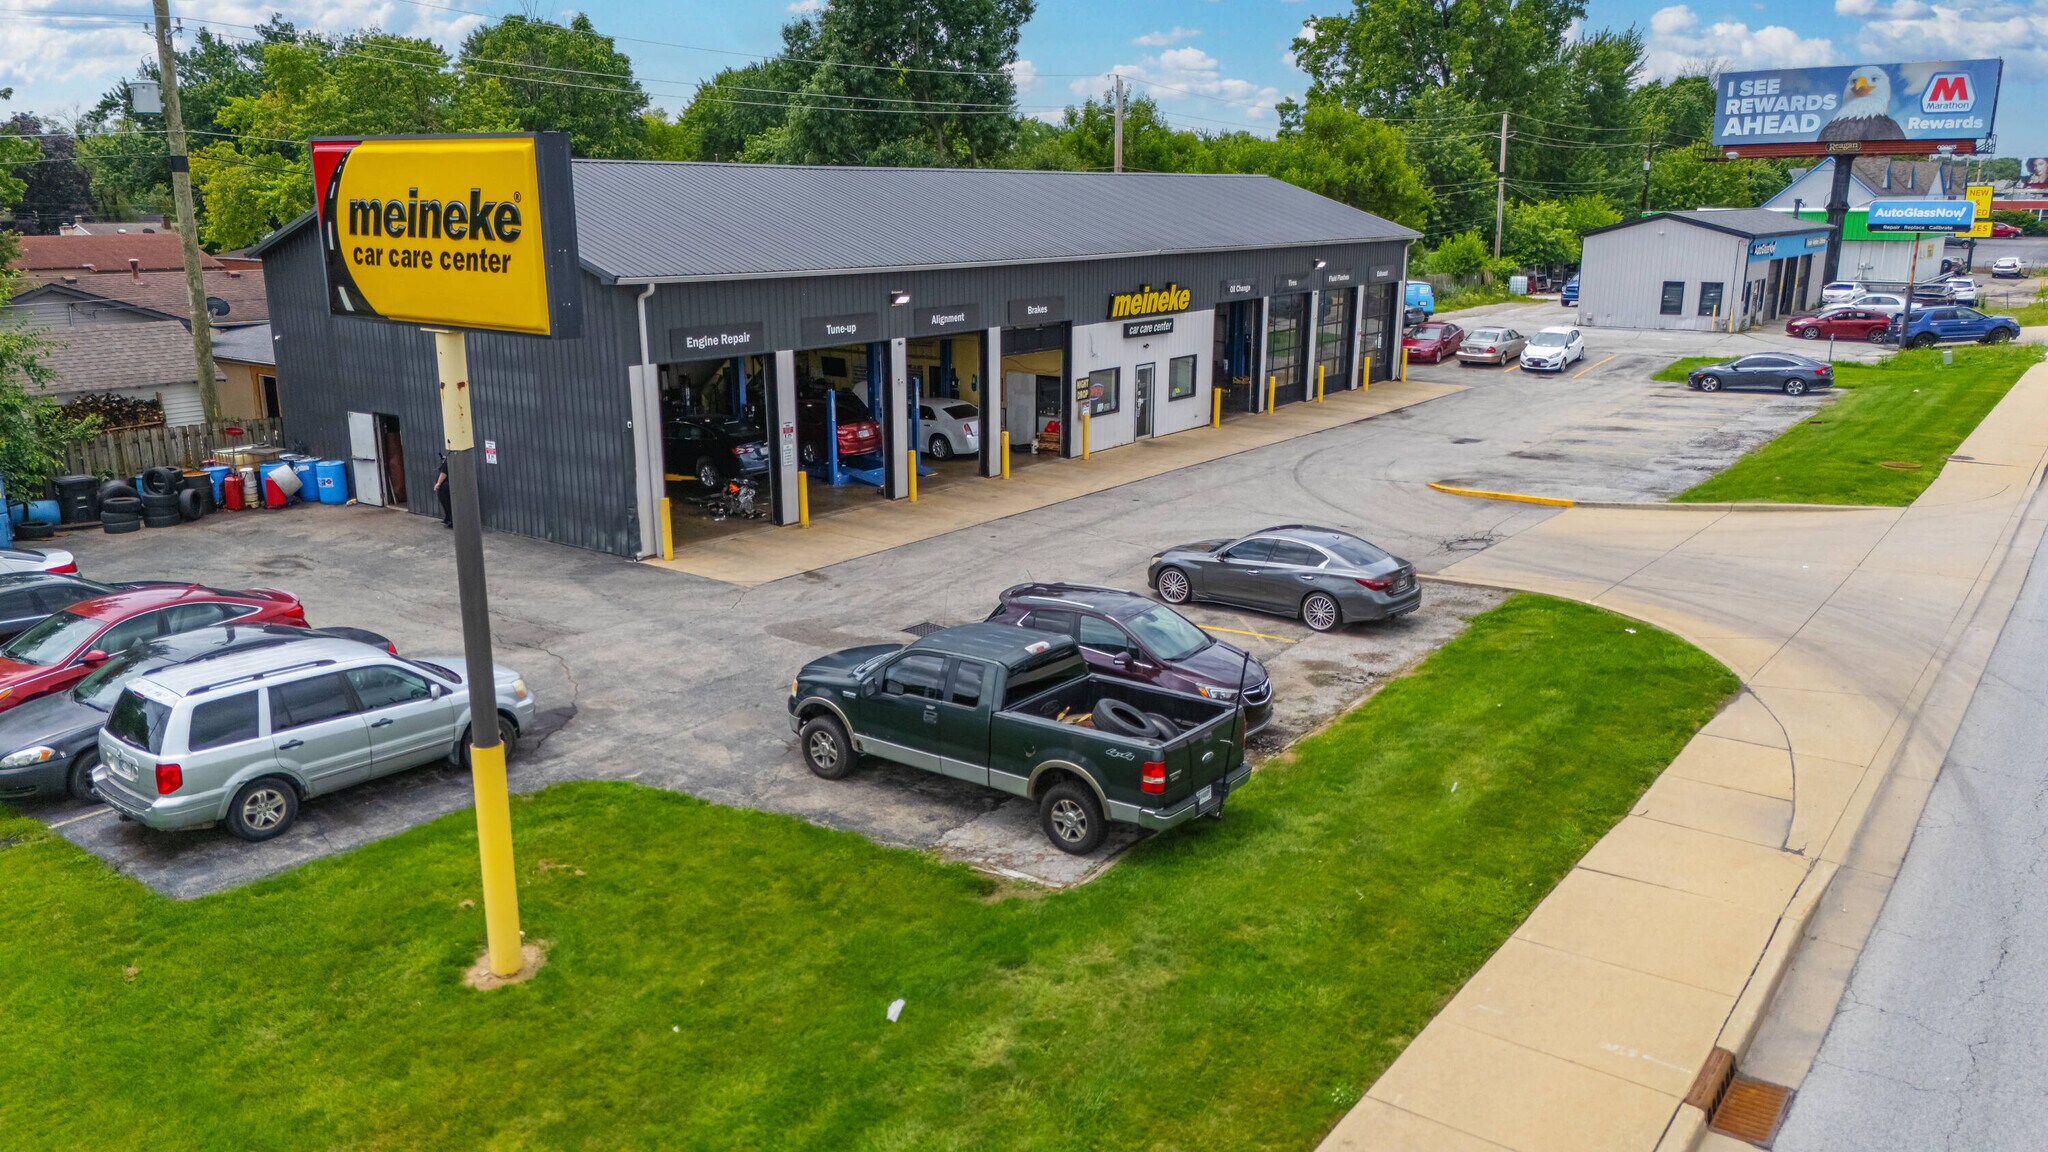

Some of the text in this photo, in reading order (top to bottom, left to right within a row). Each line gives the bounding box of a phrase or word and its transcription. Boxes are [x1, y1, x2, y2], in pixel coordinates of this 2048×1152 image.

[1727, 78, 1781, 98] I SEE
[1928, 76, 1970, 102] M
[1725, 93, 1837, 115] REWARDS
[1925, 101, 1970, 111] Marathon
[1721, 113, 1822, 137] AHEAD
[1907, 115, 1984, 130] Rewards
[1828, 142, 1859, 152] Reagan
[1969, 189, 1990, 197] NEW
[1874, 206, 1967, 222] AutoGlassNow!
[1976, 209, 1988, 217] ED
[353, 246, 511, 274] car care center
[1236, 284, 1251, 293] Change
[1288, 278, 1298, 287] Tires
[1112, 284, 1191, 317] meineke
[1027, 304, 1048, 315] Brakes
[931, 312, 965, 326] Alignment
[826, 323, 857, 335] Tune-up
[1128, 321, 1172, 335] car care center
[686, 332, 751, 350] Engine Repair
[1077, 389, 1088, 400] DROP
